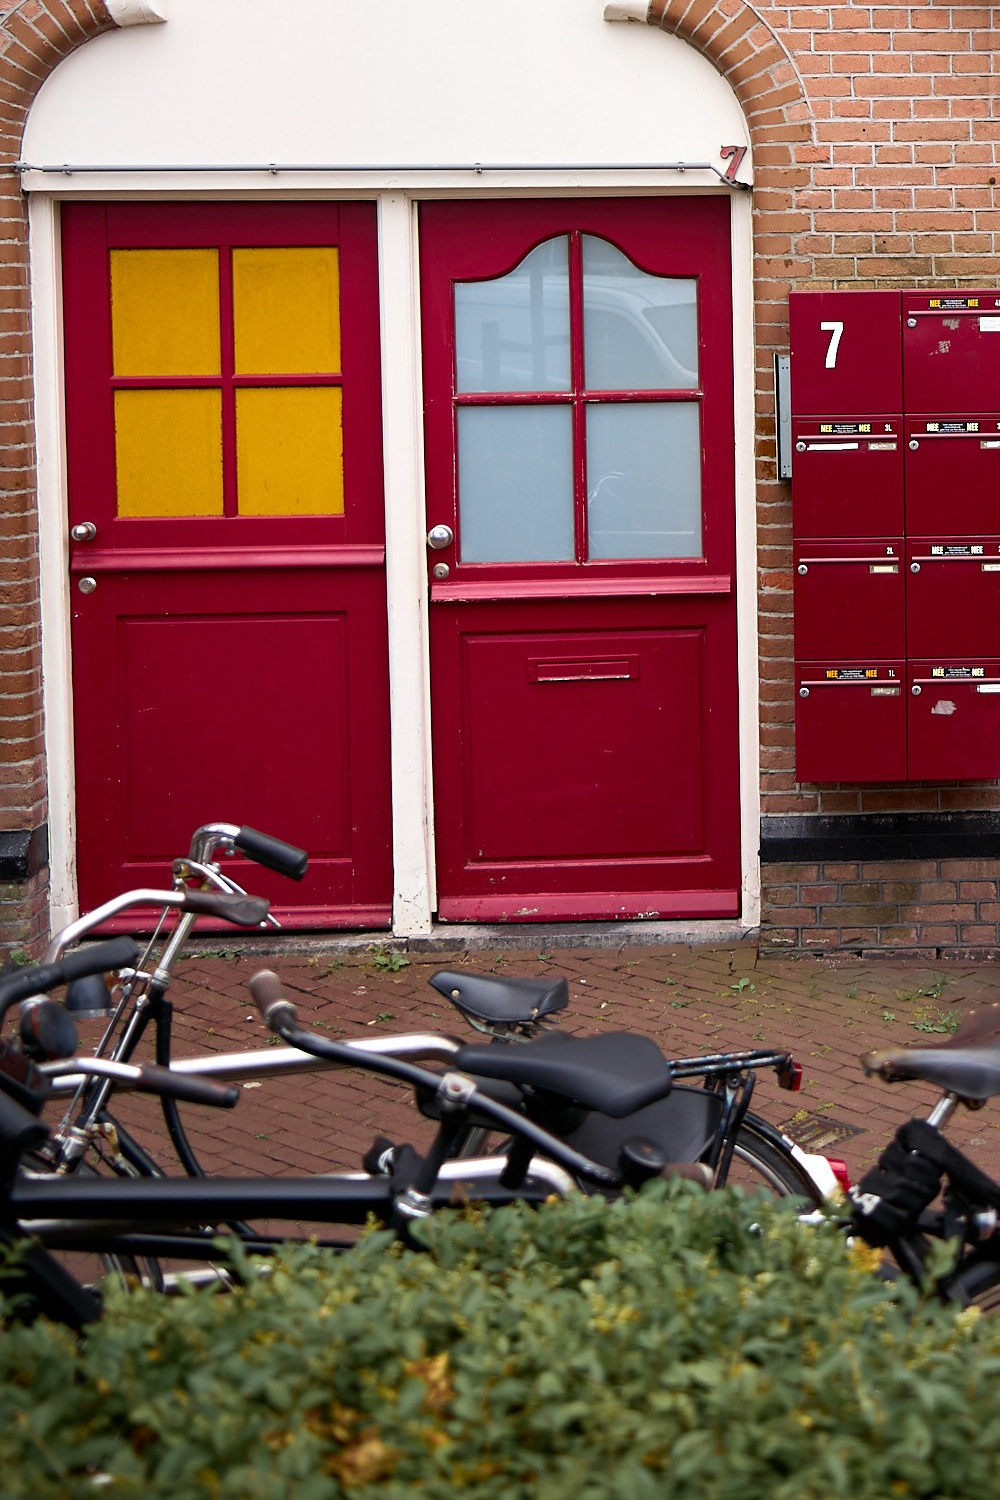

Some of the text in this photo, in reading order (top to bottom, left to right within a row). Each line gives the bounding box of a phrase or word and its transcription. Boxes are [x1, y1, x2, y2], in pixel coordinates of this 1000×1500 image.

[720, 145, 748, 184] 7
[930, 300, 941, 308] NEE
[968, 299, 979, 307] NEE
[820, 321, 844, 368] 7
[821, 425, 833, 433] NEE
[859, 424, 871, 432] NEE
[927, 423, 939, 431] NEE
[967, 423, 979, 431] NEE
[932, 546, 944, 554] NEE
[971, 546, 983, 554] NEE
[826, 670, 838, 678] NEE
[866, 670, 878, 678] NEE
[933, 669, 945, 677] NEE
[972, 668, 984, 677] NEE
